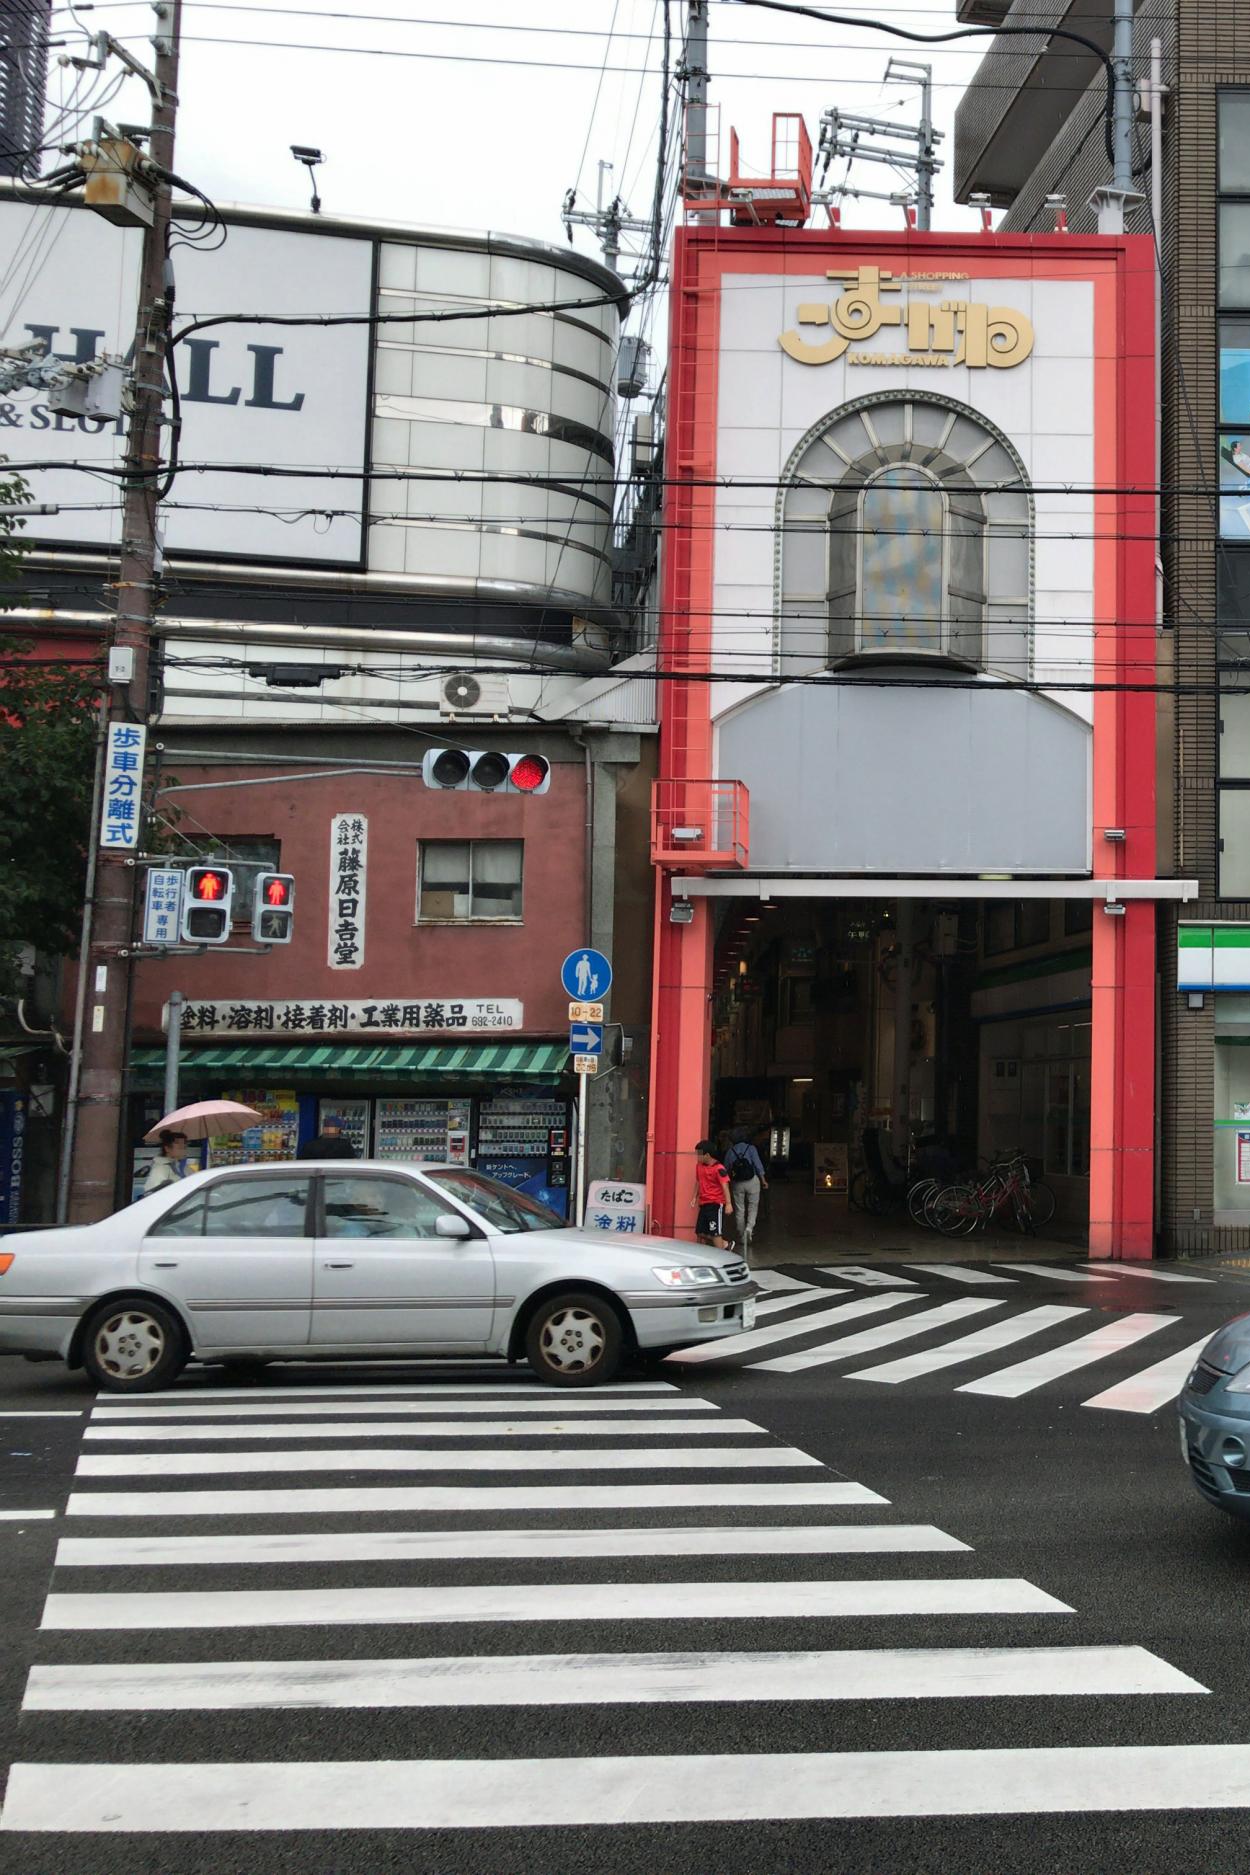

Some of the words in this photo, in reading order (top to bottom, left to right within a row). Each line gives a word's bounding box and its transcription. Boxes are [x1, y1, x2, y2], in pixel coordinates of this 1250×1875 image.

[911, 271, 969, 281] SHOPPING
[24, 323, 305, 411] HLL
[847, 352, 949, 367] KOMAGAWA
[105, 727, 142, 845] 歩車分離式
[476, 1004, 504, 1014] TEL
[571, 1006, 602, 1018] 10-22
[10, 1136, 24, 1188] BOSS
[600, 1189, 634, 1204] たばこ
